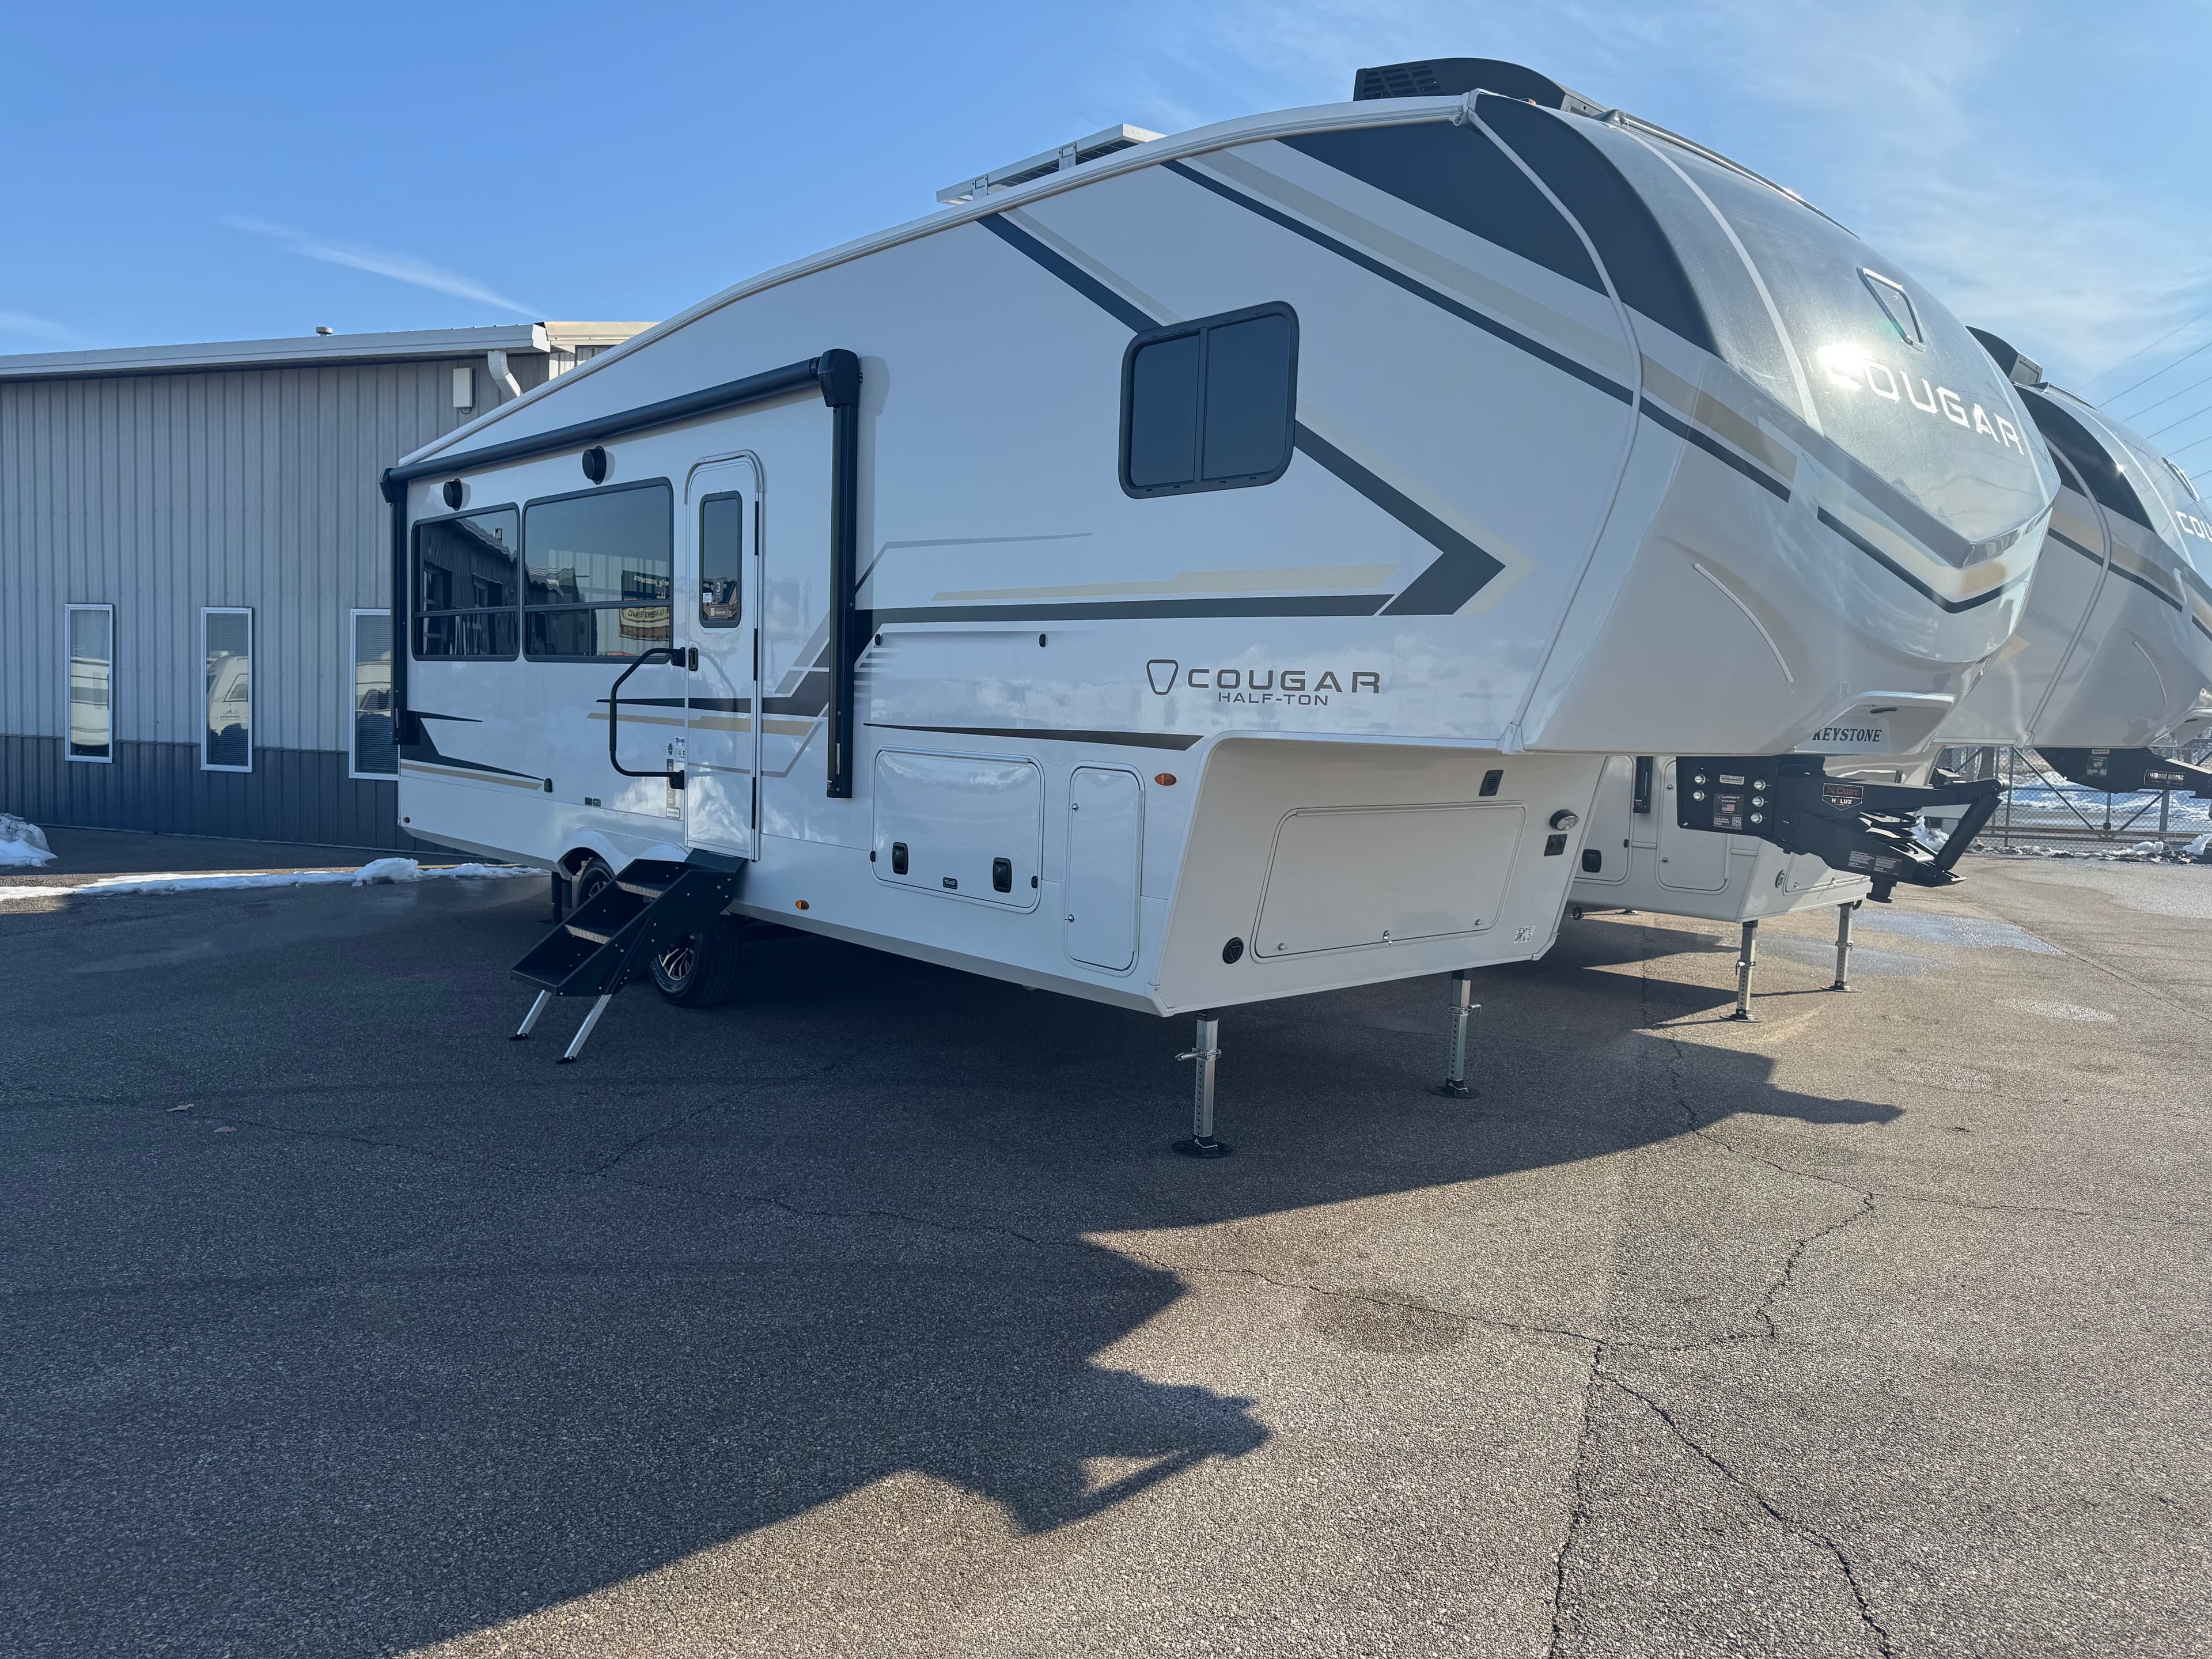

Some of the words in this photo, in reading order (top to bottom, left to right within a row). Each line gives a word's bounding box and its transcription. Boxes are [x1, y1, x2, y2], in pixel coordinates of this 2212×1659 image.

[2176, 510, 2212, 543] COU
[1188, 669, 1380, 694] COUGAR
[1218, 692, 1328, 706] HALF-TON
